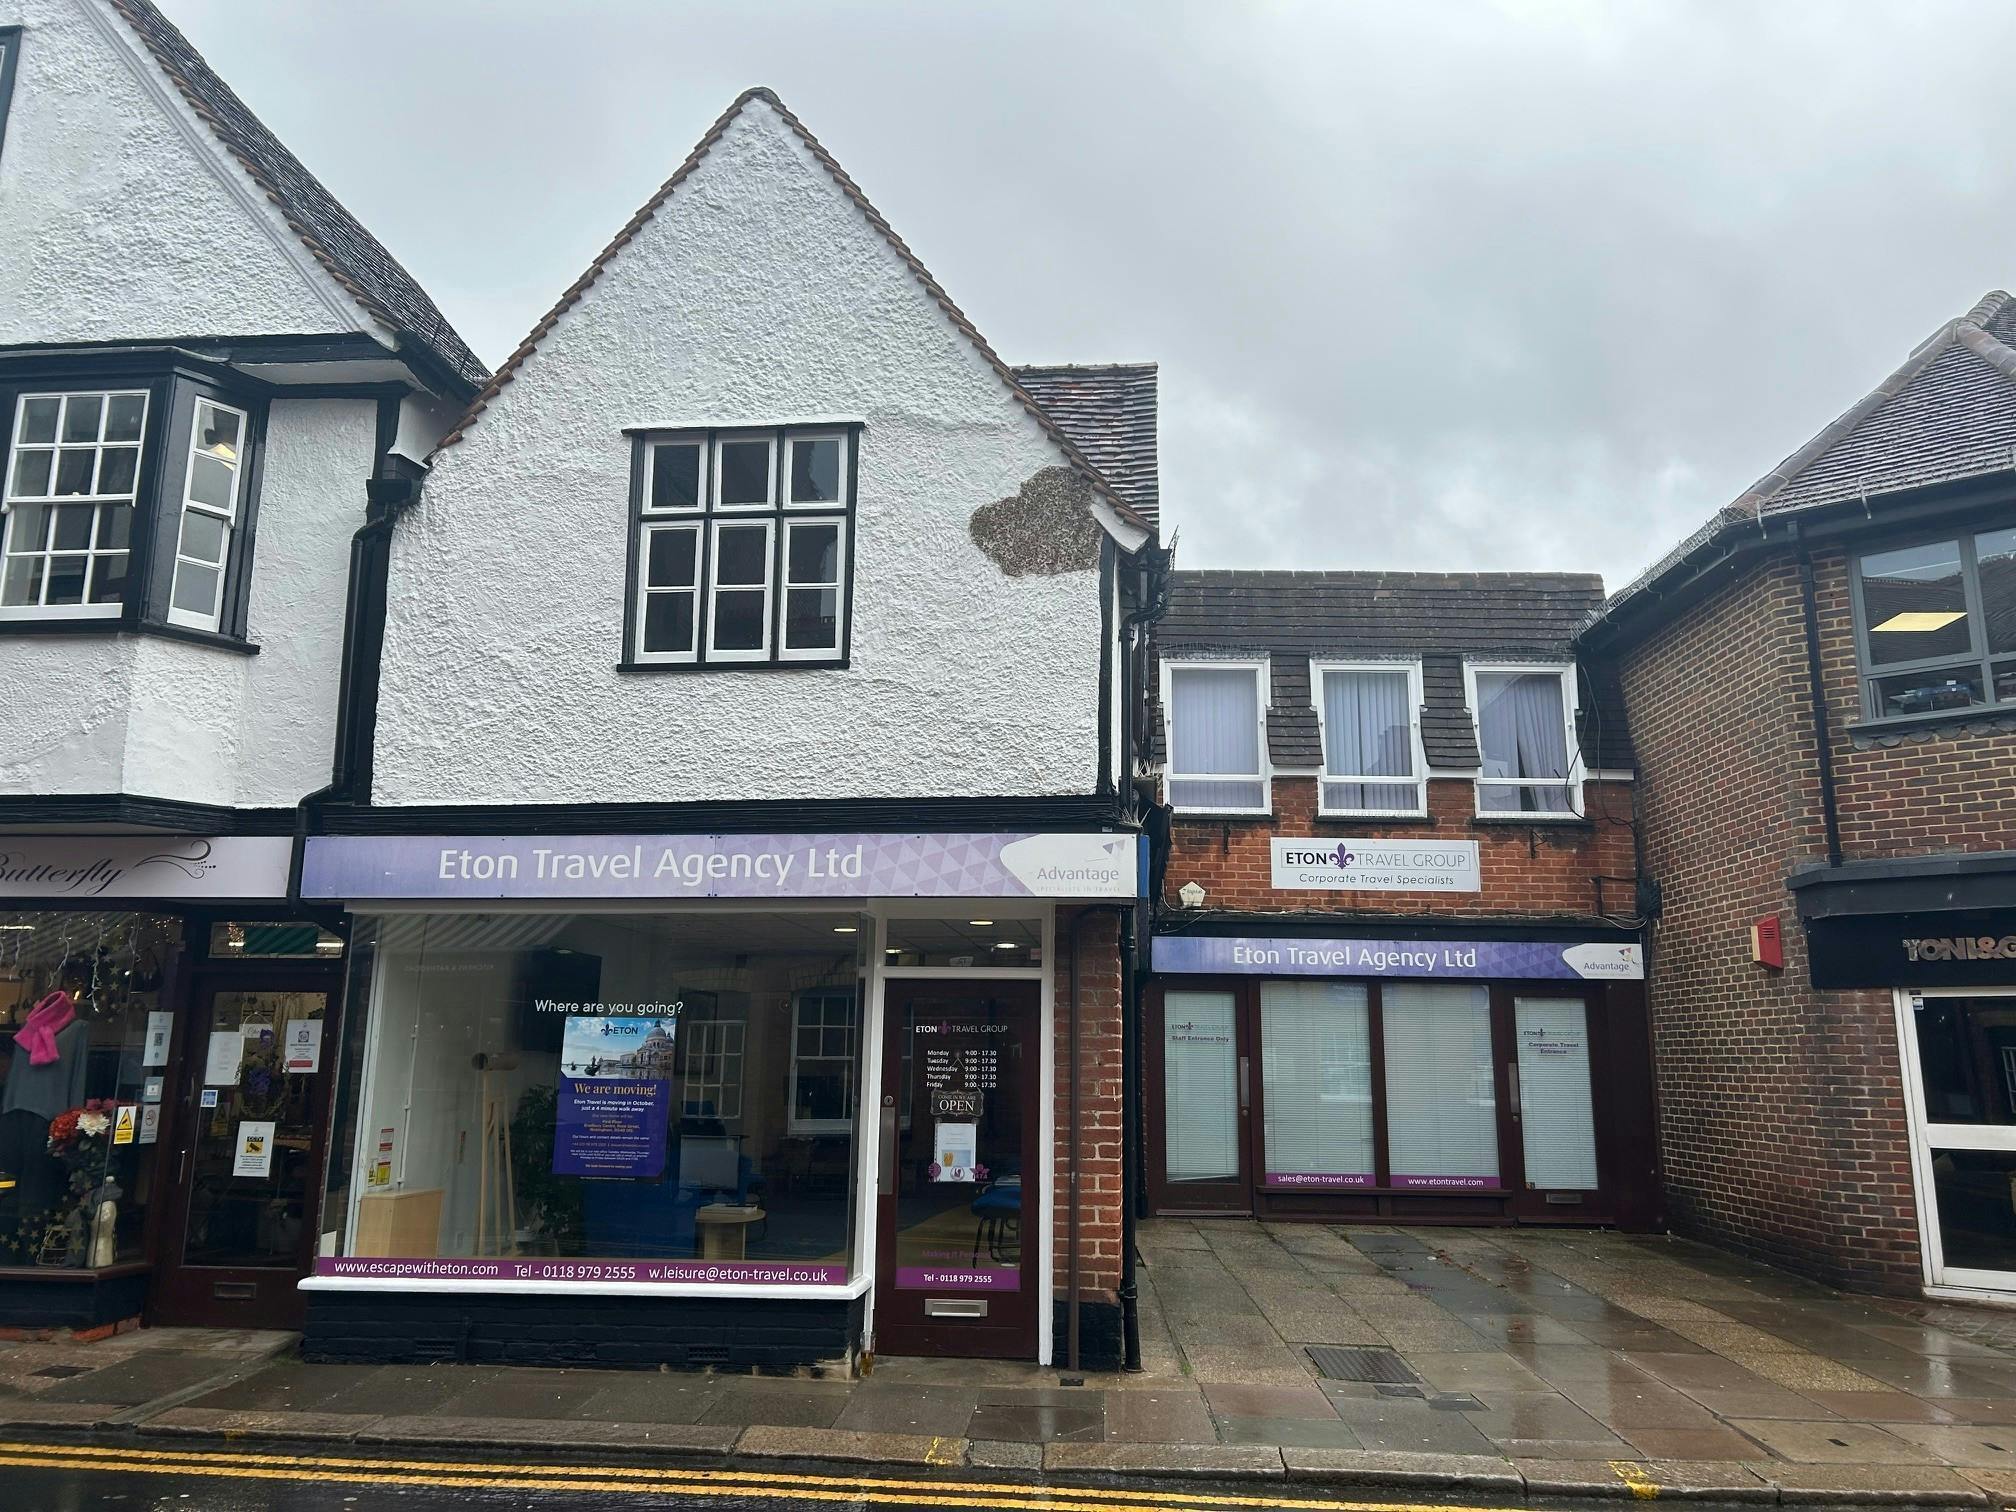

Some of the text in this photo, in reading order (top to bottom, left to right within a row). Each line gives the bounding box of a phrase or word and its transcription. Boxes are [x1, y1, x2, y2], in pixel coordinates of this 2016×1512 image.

[439, 844, 863, 887] Eton Travel Agency Ltd
[1286, 852, 1466, 868] ETON TRAVEL GROUP
[1037, 866, 1120, 883] Advantage
[1299, 873, 1454, 886] Corporate Travel Specialists
[1234, 946, 1476, 972] Eton Travel Agency Ltd
[1584, 961, 1630, 972] Advantage
[535, 1000, 684, 1016] Where are you going?
[613, 1026, 639, 1035] ETON
[915, 1025, 1008, 1033] ETON TRAVEL GROUP
[574, 1083, 657, 1097] We are moving!
[939, 1100, 975, 1111] OPEN
[1278, 1175, 1374, 1184] sales@eton-travel.co.uk
[1408, 1178, 1485, 1187] www.etontravel.com
[335, 1262, 499, 1276] www.escapewitheton.com
[514, 1264, 532, 1277] Tel
[543, 1265, 575, 1278] 0118
[577, 1265, 601, 1278] 979
[604, 1266, 636, 1279] 2555
[648, 1266, 828, 1282] w.leisure@eton-travel.co.uk
